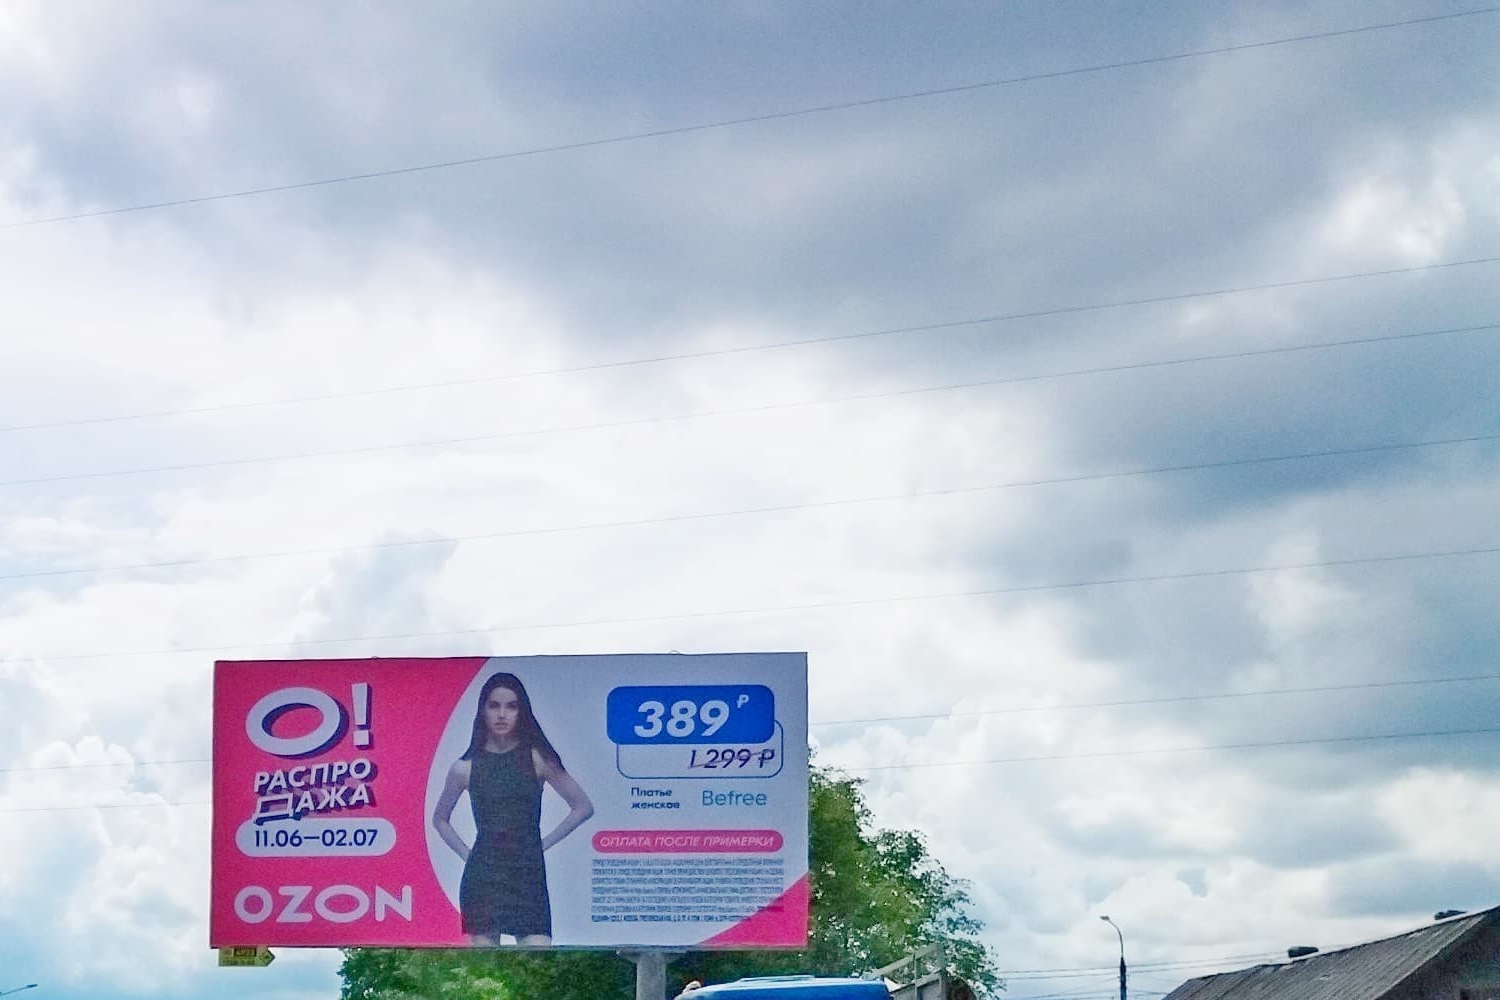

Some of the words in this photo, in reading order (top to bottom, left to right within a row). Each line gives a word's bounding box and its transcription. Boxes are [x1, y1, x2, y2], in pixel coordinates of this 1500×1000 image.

[634, 700, 730, 738] 389
[254, 758, 373, 793] РАСПРО
[631, 787, 673, 797] Платье
[254, 784, 372, 819] ДАЖА
[702, 790, 768, 806] Befree
[600, 837, 651, 847] ОПЛАТА
[655, 836, 699, 847] ПОСЛЕ
[703, 836, 774, 847] ПРИМЕРКИ
[234, 884, 412, 923] OZON
